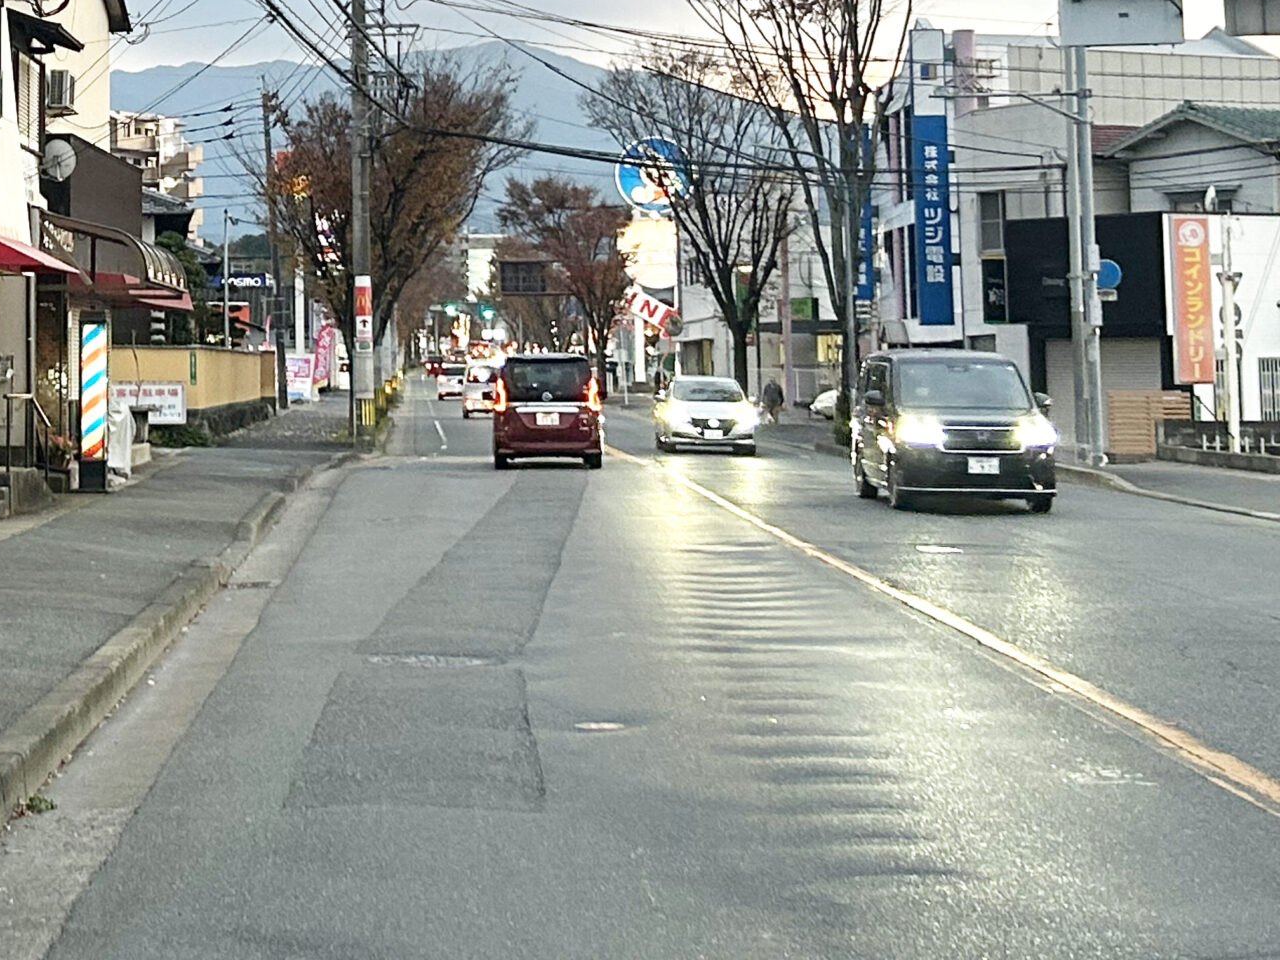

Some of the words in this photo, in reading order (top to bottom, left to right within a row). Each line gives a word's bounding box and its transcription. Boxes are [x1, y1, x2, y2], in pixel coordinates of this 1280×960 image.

[1183, 248, 1206, 378] コインランドリー
